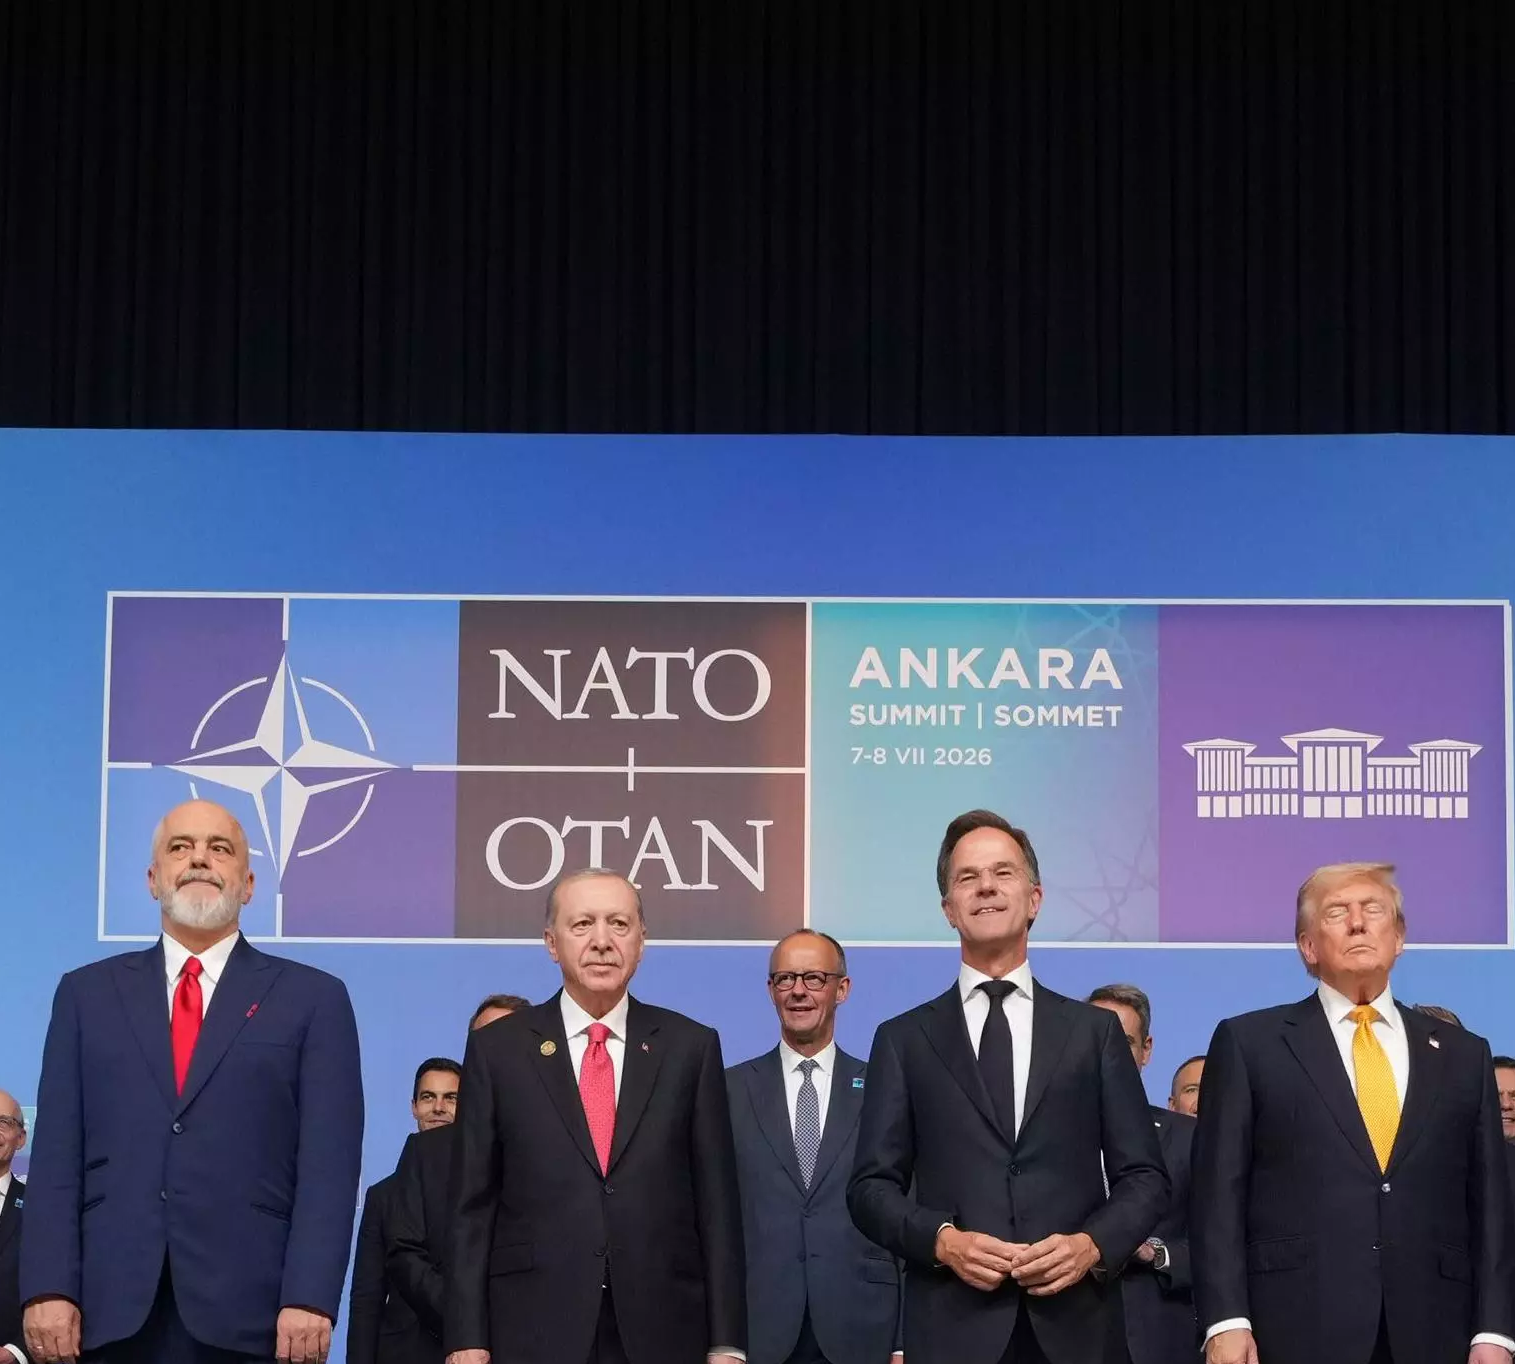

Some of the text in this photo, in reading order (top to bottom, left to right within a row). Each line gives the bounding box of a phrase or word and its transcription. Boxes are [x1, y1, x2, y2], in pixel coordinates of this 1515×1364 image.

[488, 646, 772, 722] NATO
[848, 646, 1124, 690] ANKARA
[848, 703, 967, 727] SUMMIT
[993, 704, 1124, 728] SOMMET
[850, 746, 993, 766] 7-8 VII 2026
[485, 815, 774, 892] OTAN
